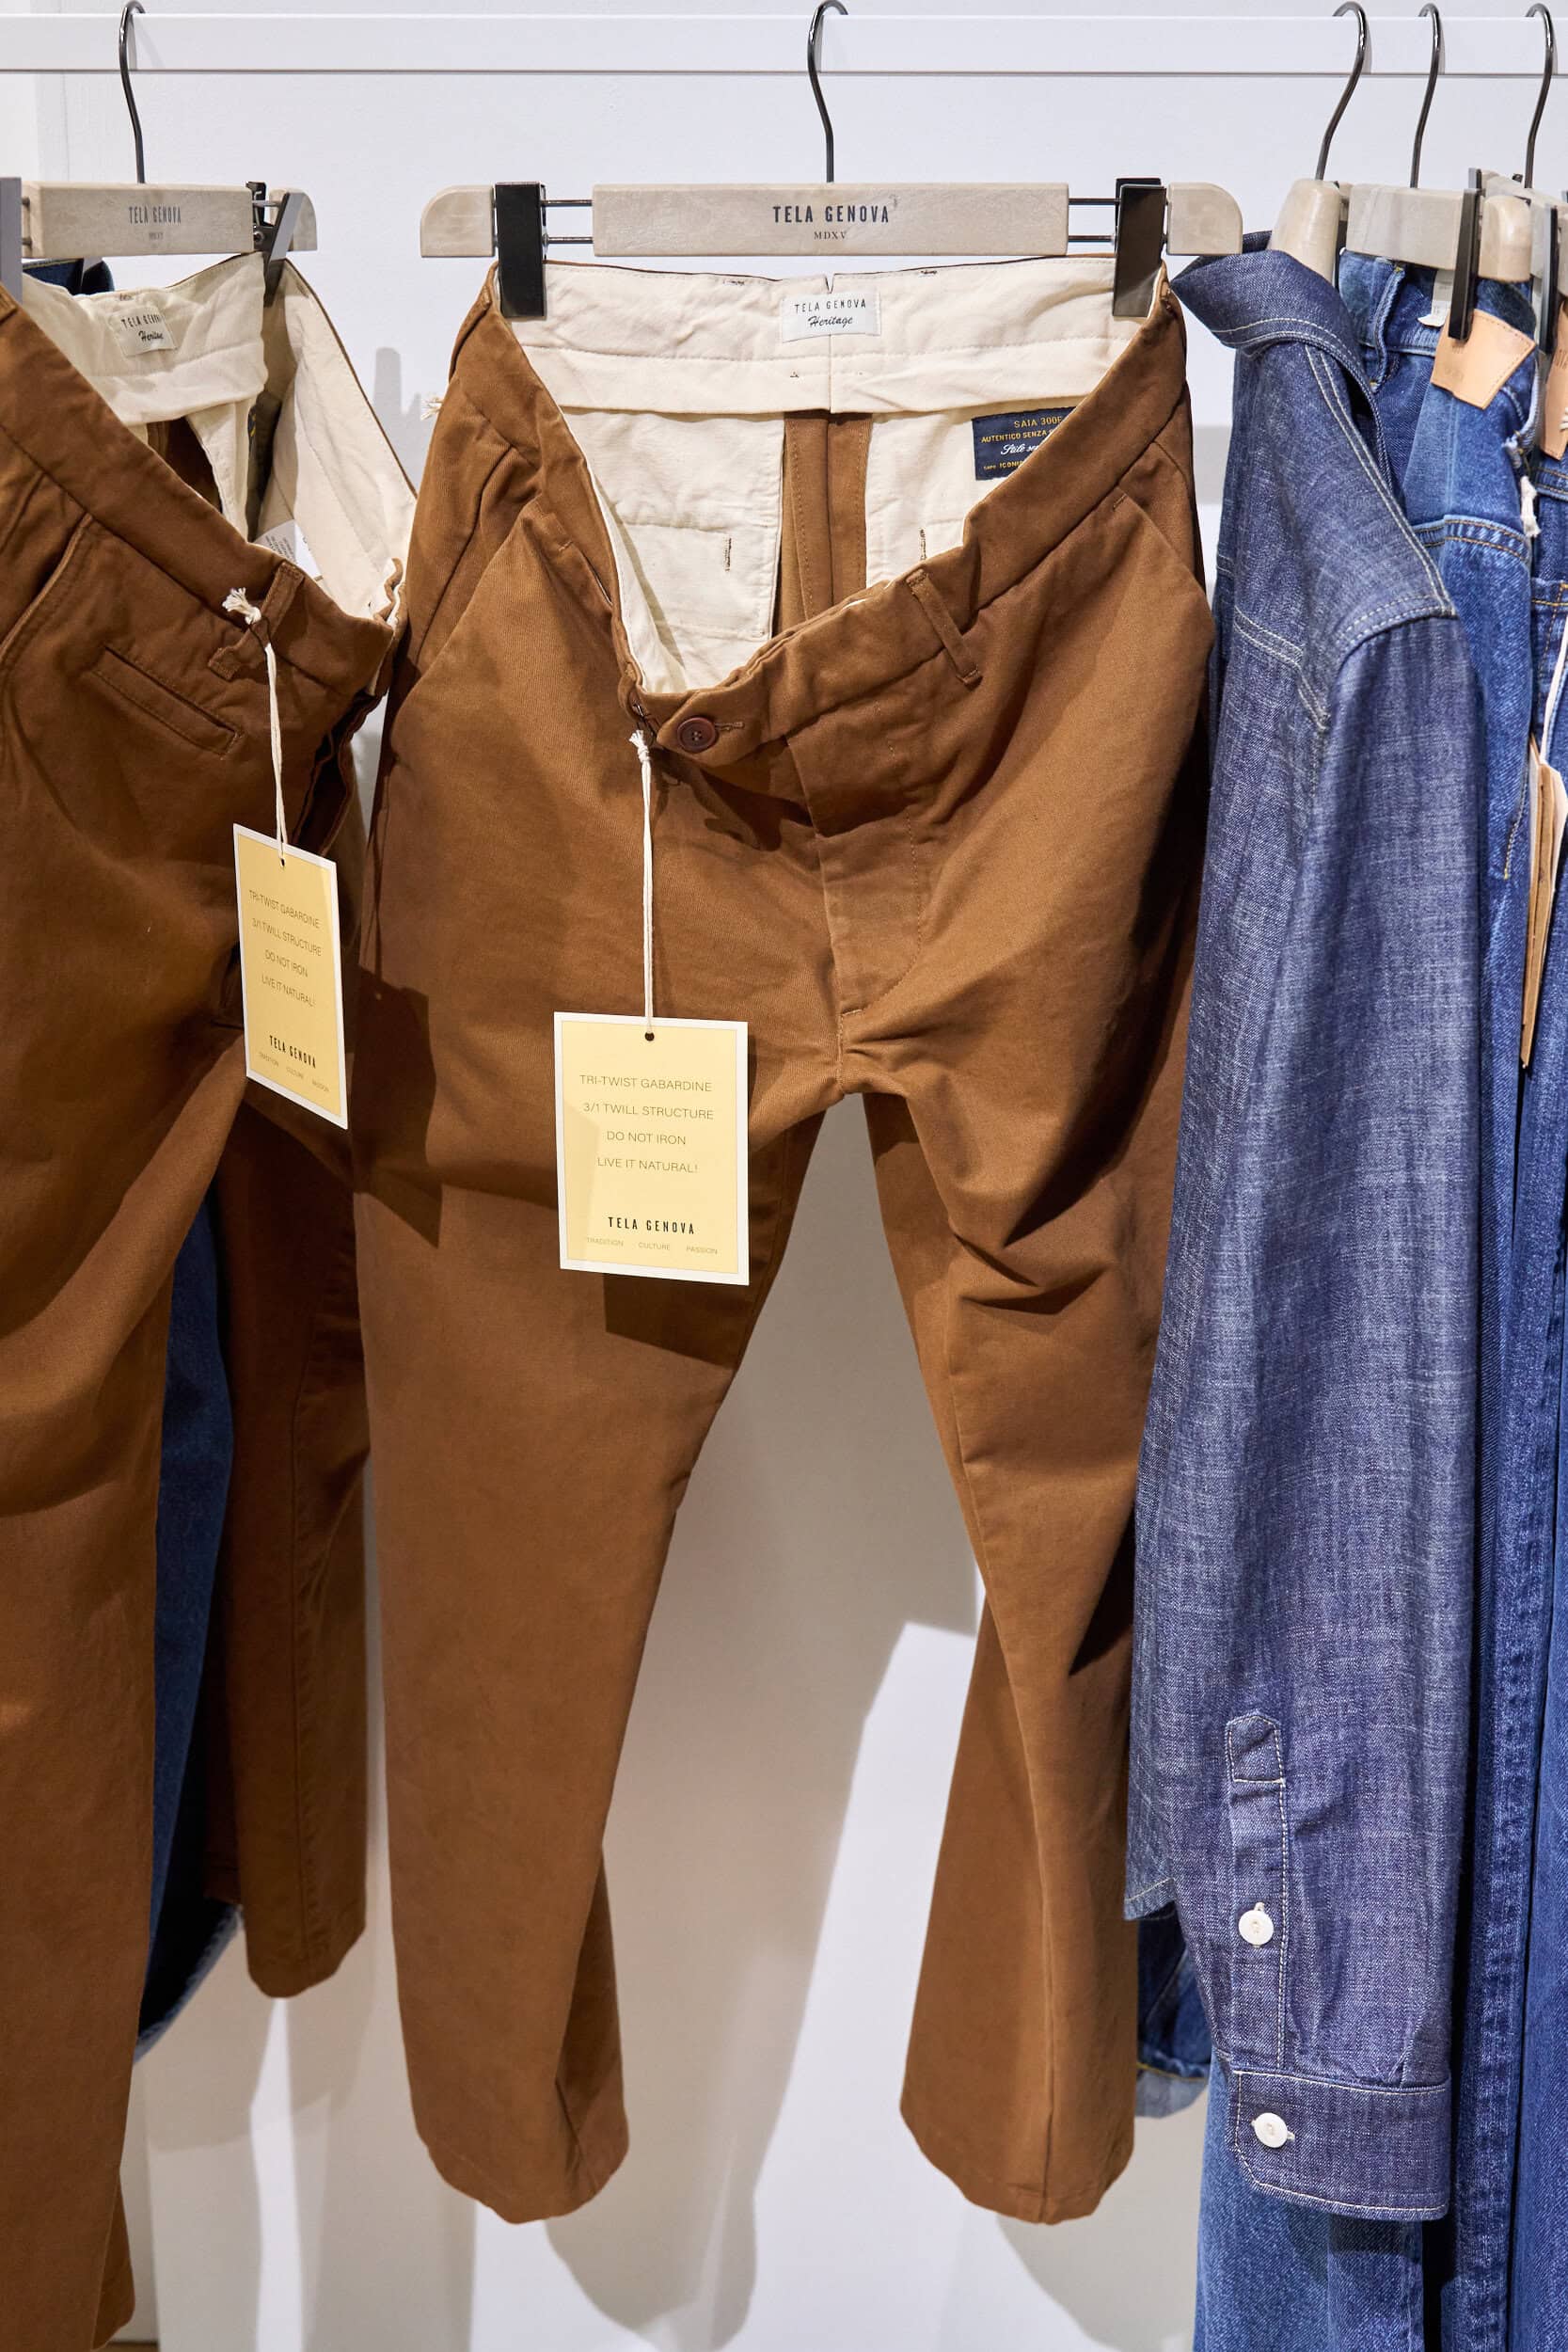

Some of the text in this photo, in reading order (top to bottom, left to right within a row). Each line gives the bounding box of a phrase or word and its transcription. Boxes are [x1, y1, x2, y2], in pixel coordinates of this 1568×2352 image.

[129, 206, 149, 224] TELA
[773, 205, 889, 223] TELA GENOVA
[814, 231, 847, 240] MDXV
[795, 298, 866, 313] TELA GENOVA
[807, 315, 853, 327] Heritage
[1014, 419, 1037, 428] SAIA
[981, 433, 1022, 443] AUTENTICO
[1022, 430, 1047, 438] SENZA
[280, 904, 321, 929] GABARDINE
[282, 931, 322, 957] STRUCTURE
[264, 949, 276, 961] DO
[277, 955, 291, 968] NOT
[269, 1035, 316, 1070] TELA GENOVA
[579, 1074, 713, 1092] TRI-TWIST GABARDINE
[583, 1103, 715, 1120] 3/1 TWILL STRUCTURE
[607, 1131, 686, 1145] DO NOT IRON
[597, 1157, 698, 1173] LIVE IT NATURAL!
[608, 1216, 694, 1234] TELA GENOVA
[586, 1236, 719, 1255] TRADITION CULTURE PASSION
